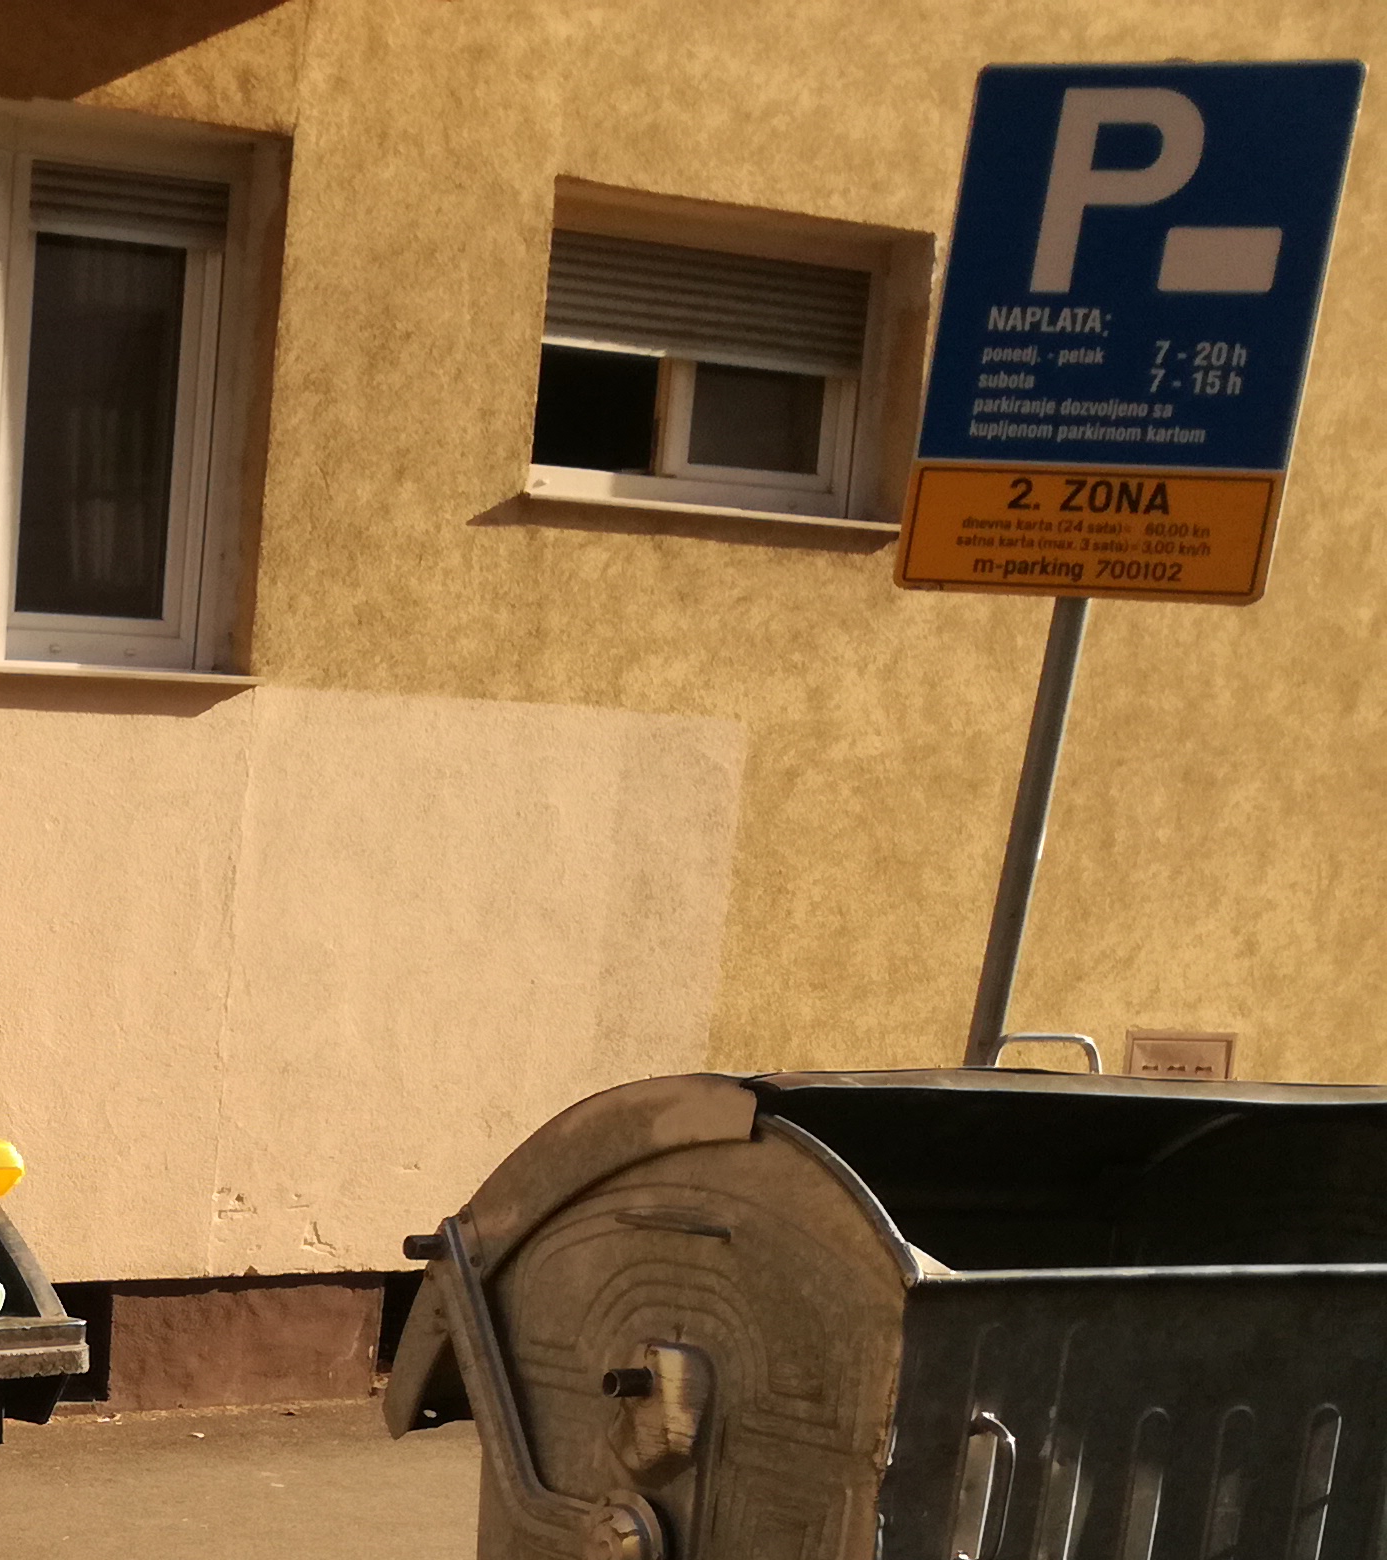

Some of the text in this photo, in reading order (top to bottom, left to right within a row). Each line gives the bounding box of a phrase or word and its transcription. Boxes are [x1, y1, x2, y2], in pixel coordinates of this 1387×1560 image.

[1029, 87, 1205, 294] P
[987, 306, 1112, 337] NAPLATA:
[1057, 345, 1106, 367] petak
[1155, 340, 1171, 365] 7
[1193, 341, 1228, 367] 20
[1232, 343, 1247, 368] h
[977, 370, 1036, 390] subota
[1149, 368, 1166, 393] 7
[1192, 370, 1222, 395] 15
[1226, 371, 1242, 395] h
[972, 395, 1173, 420] parkiranje dozvoljeno sa
[969, 418, 1207, 444] kupljenom parkirnom kartom
[1008, 477, 1171, 515] 2. ZONA
[972, 556, 1183, 582] m-parking 700102
